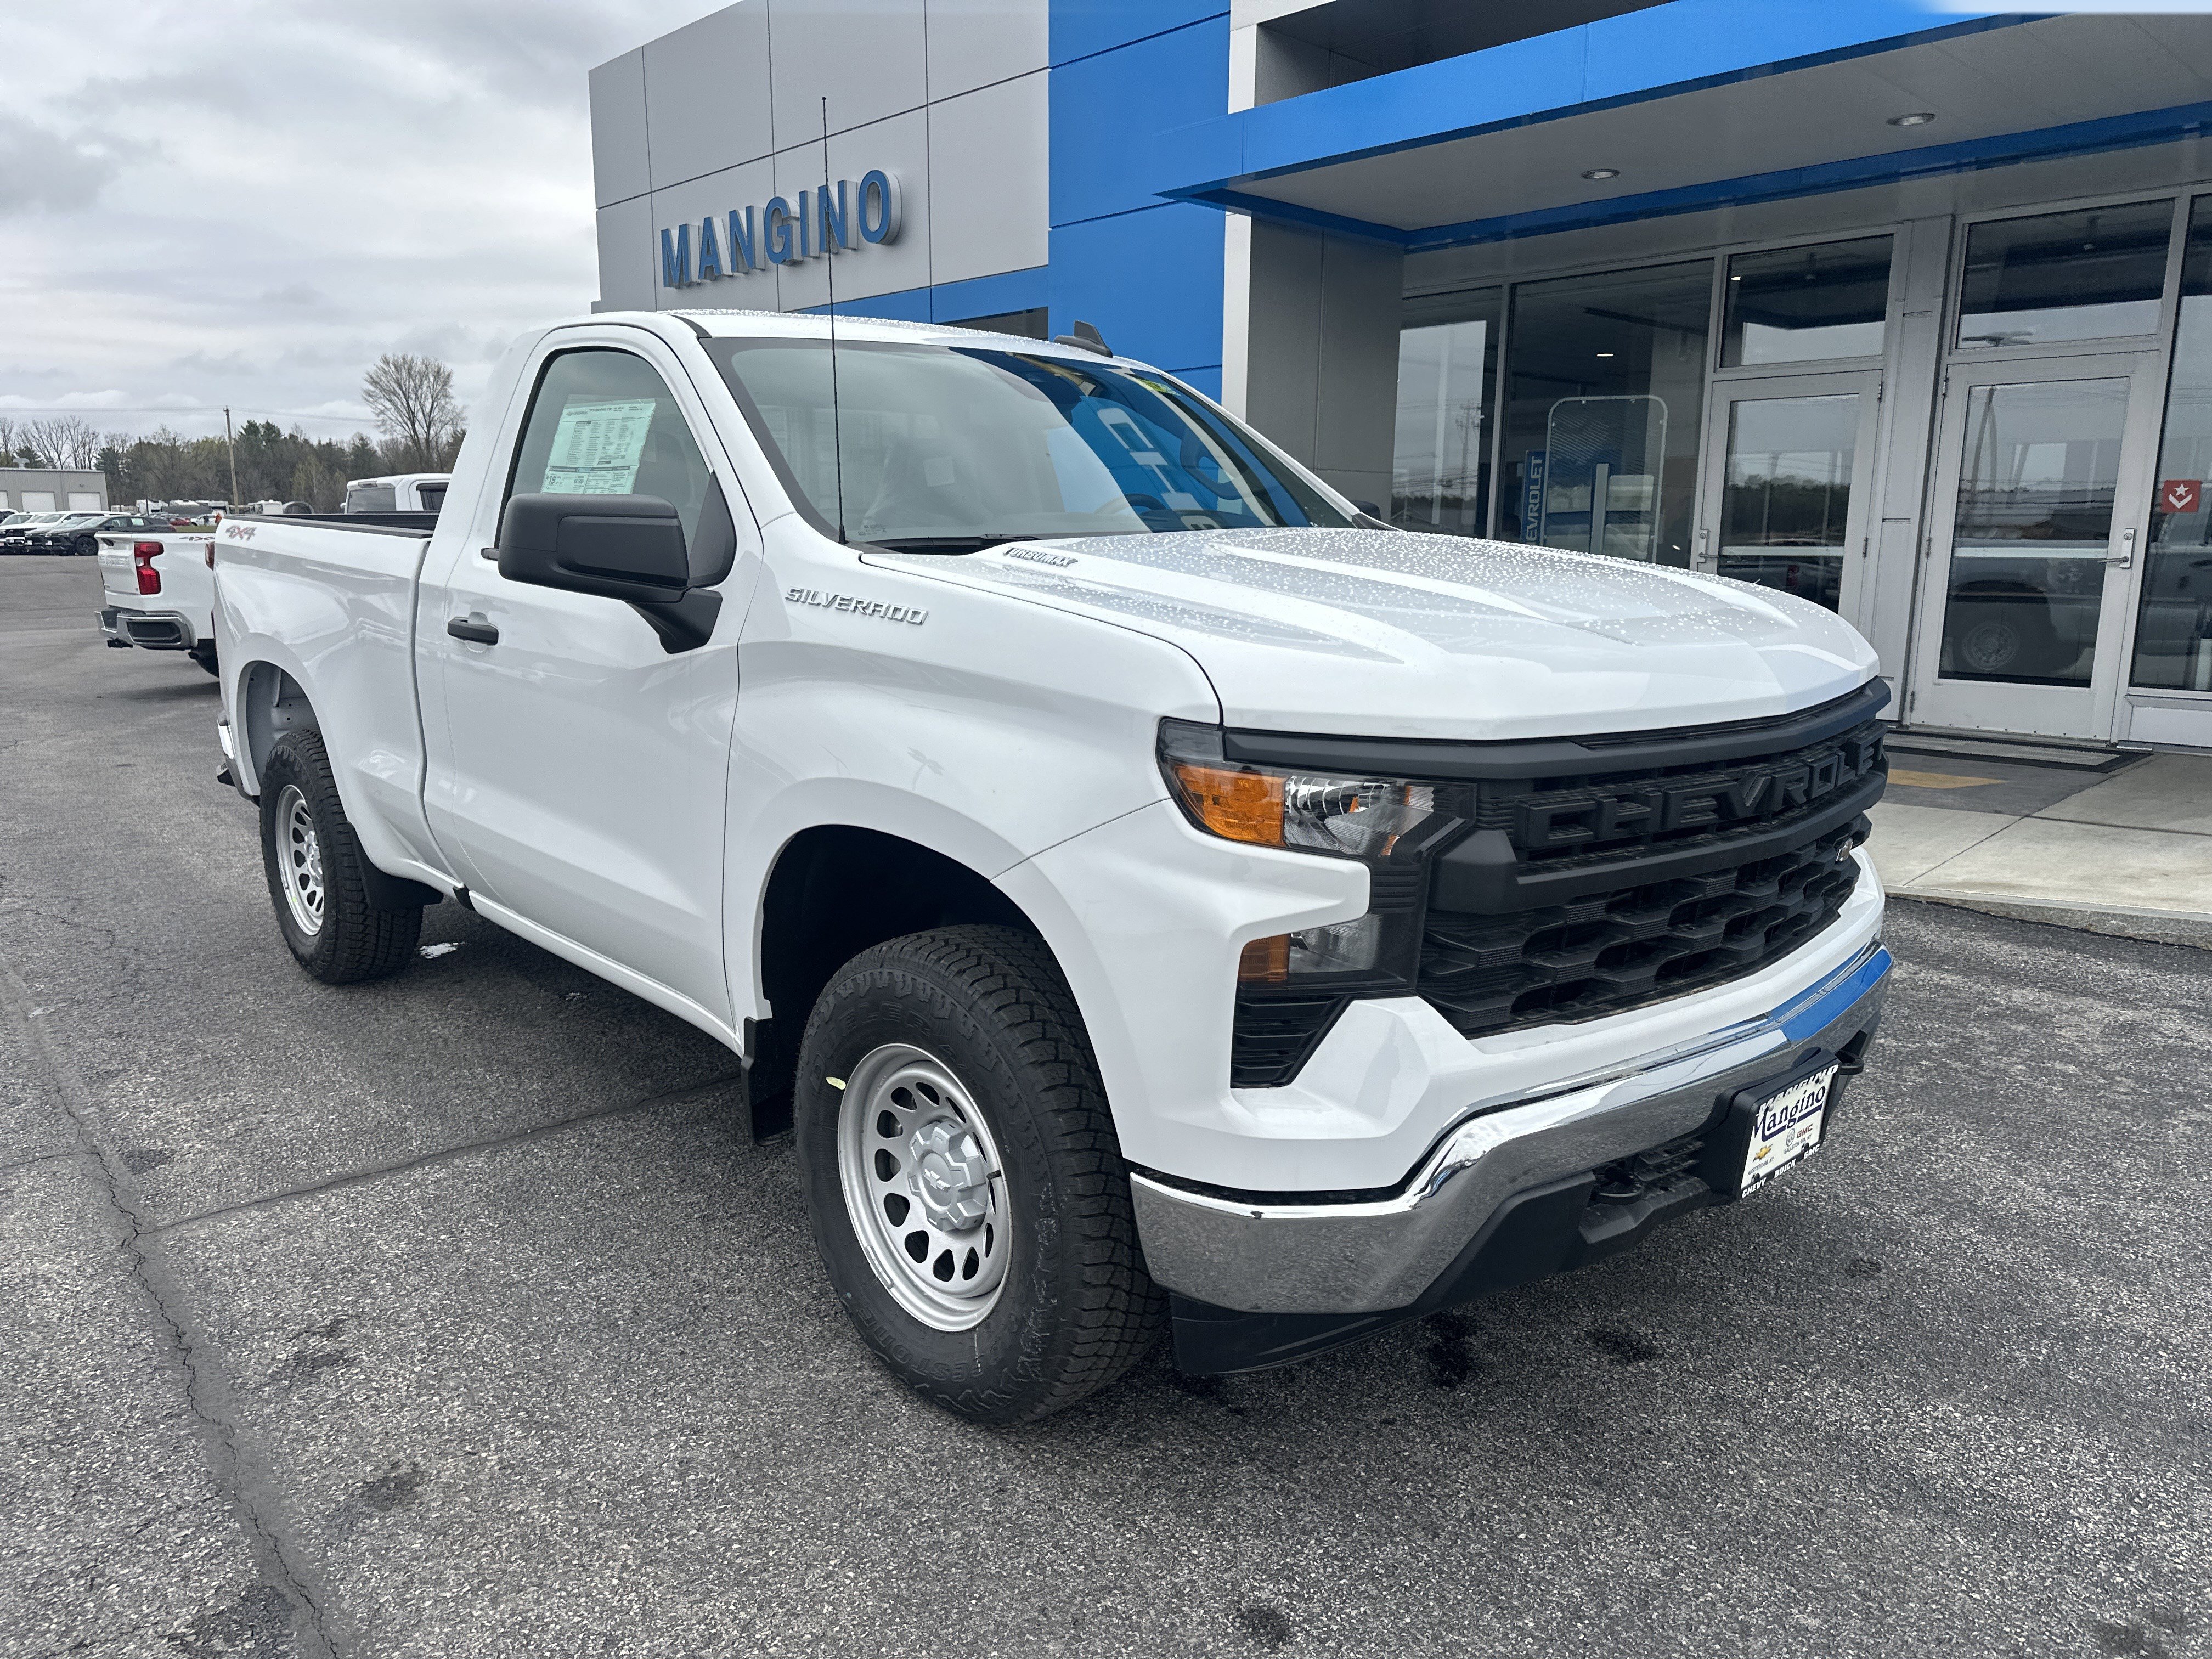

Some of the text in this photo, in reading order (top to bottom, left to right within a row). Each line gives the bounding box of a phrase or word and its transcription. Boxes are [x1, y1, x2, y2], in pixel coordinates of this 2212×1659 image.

[661, 170, 901, 288] MANGINO
[1525, 455, 1543, 546] EVROLET
[1003, 546, 1077, 567] TURBOMAX
[785, 586, 929, 625] SILVERADO
[1514, 725, 1888, 849] CHEVROLET
[1754, 1086, 1826, 1142] Mangino
[1797, 1124, 1813, 1139] GMC
[1803, 1143, 1820, 1159] GMC
[1774, 1158, 1797, 1178] BUICK
[1741, 1177, 1767, 1198] CHEVY
